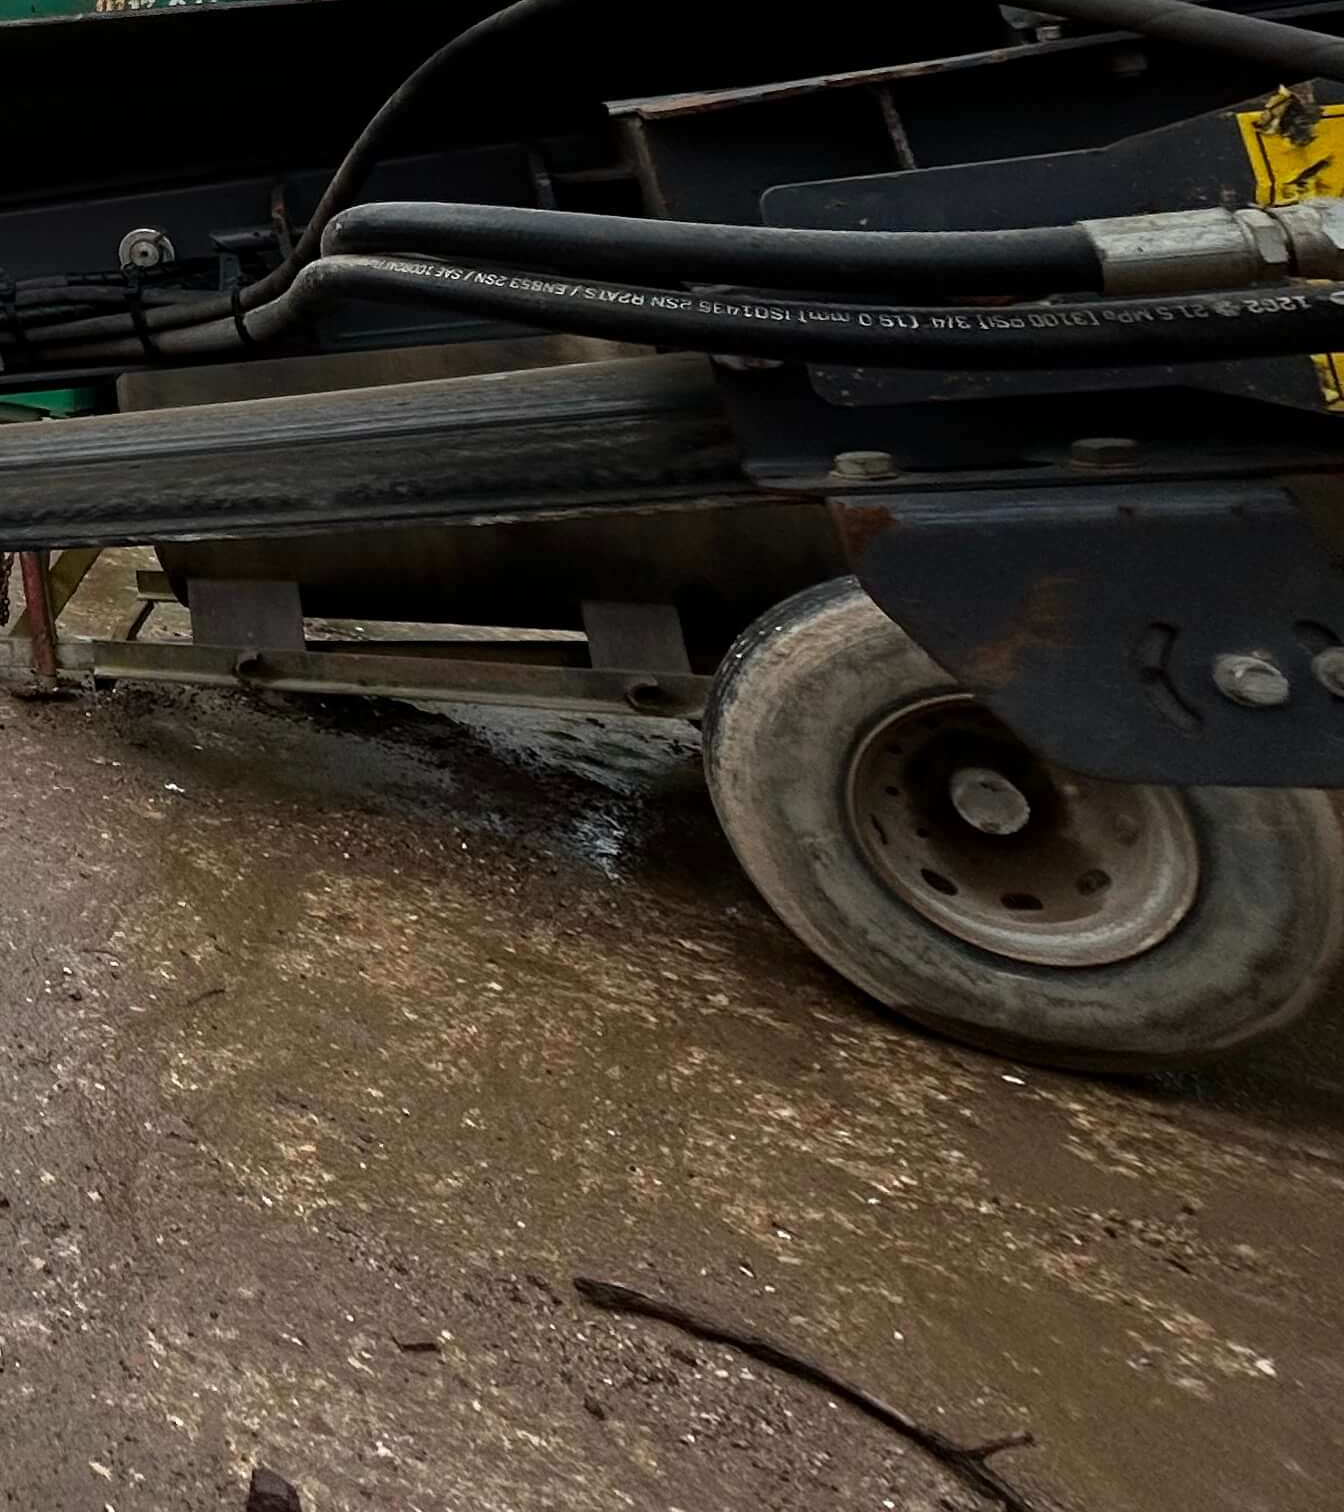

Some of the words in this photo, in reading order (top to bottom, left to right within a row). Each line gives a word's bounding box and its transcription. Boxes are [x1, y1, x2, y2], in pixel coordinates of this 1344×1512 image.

[474, 271, 508, 287] 2SN
[508, 277, 568, 295] EN853
[584, 287, 645, 306] R2ATS
[649, 296, 692, 311] 2SN
[1241, 295, 1312, 314] 12G2
